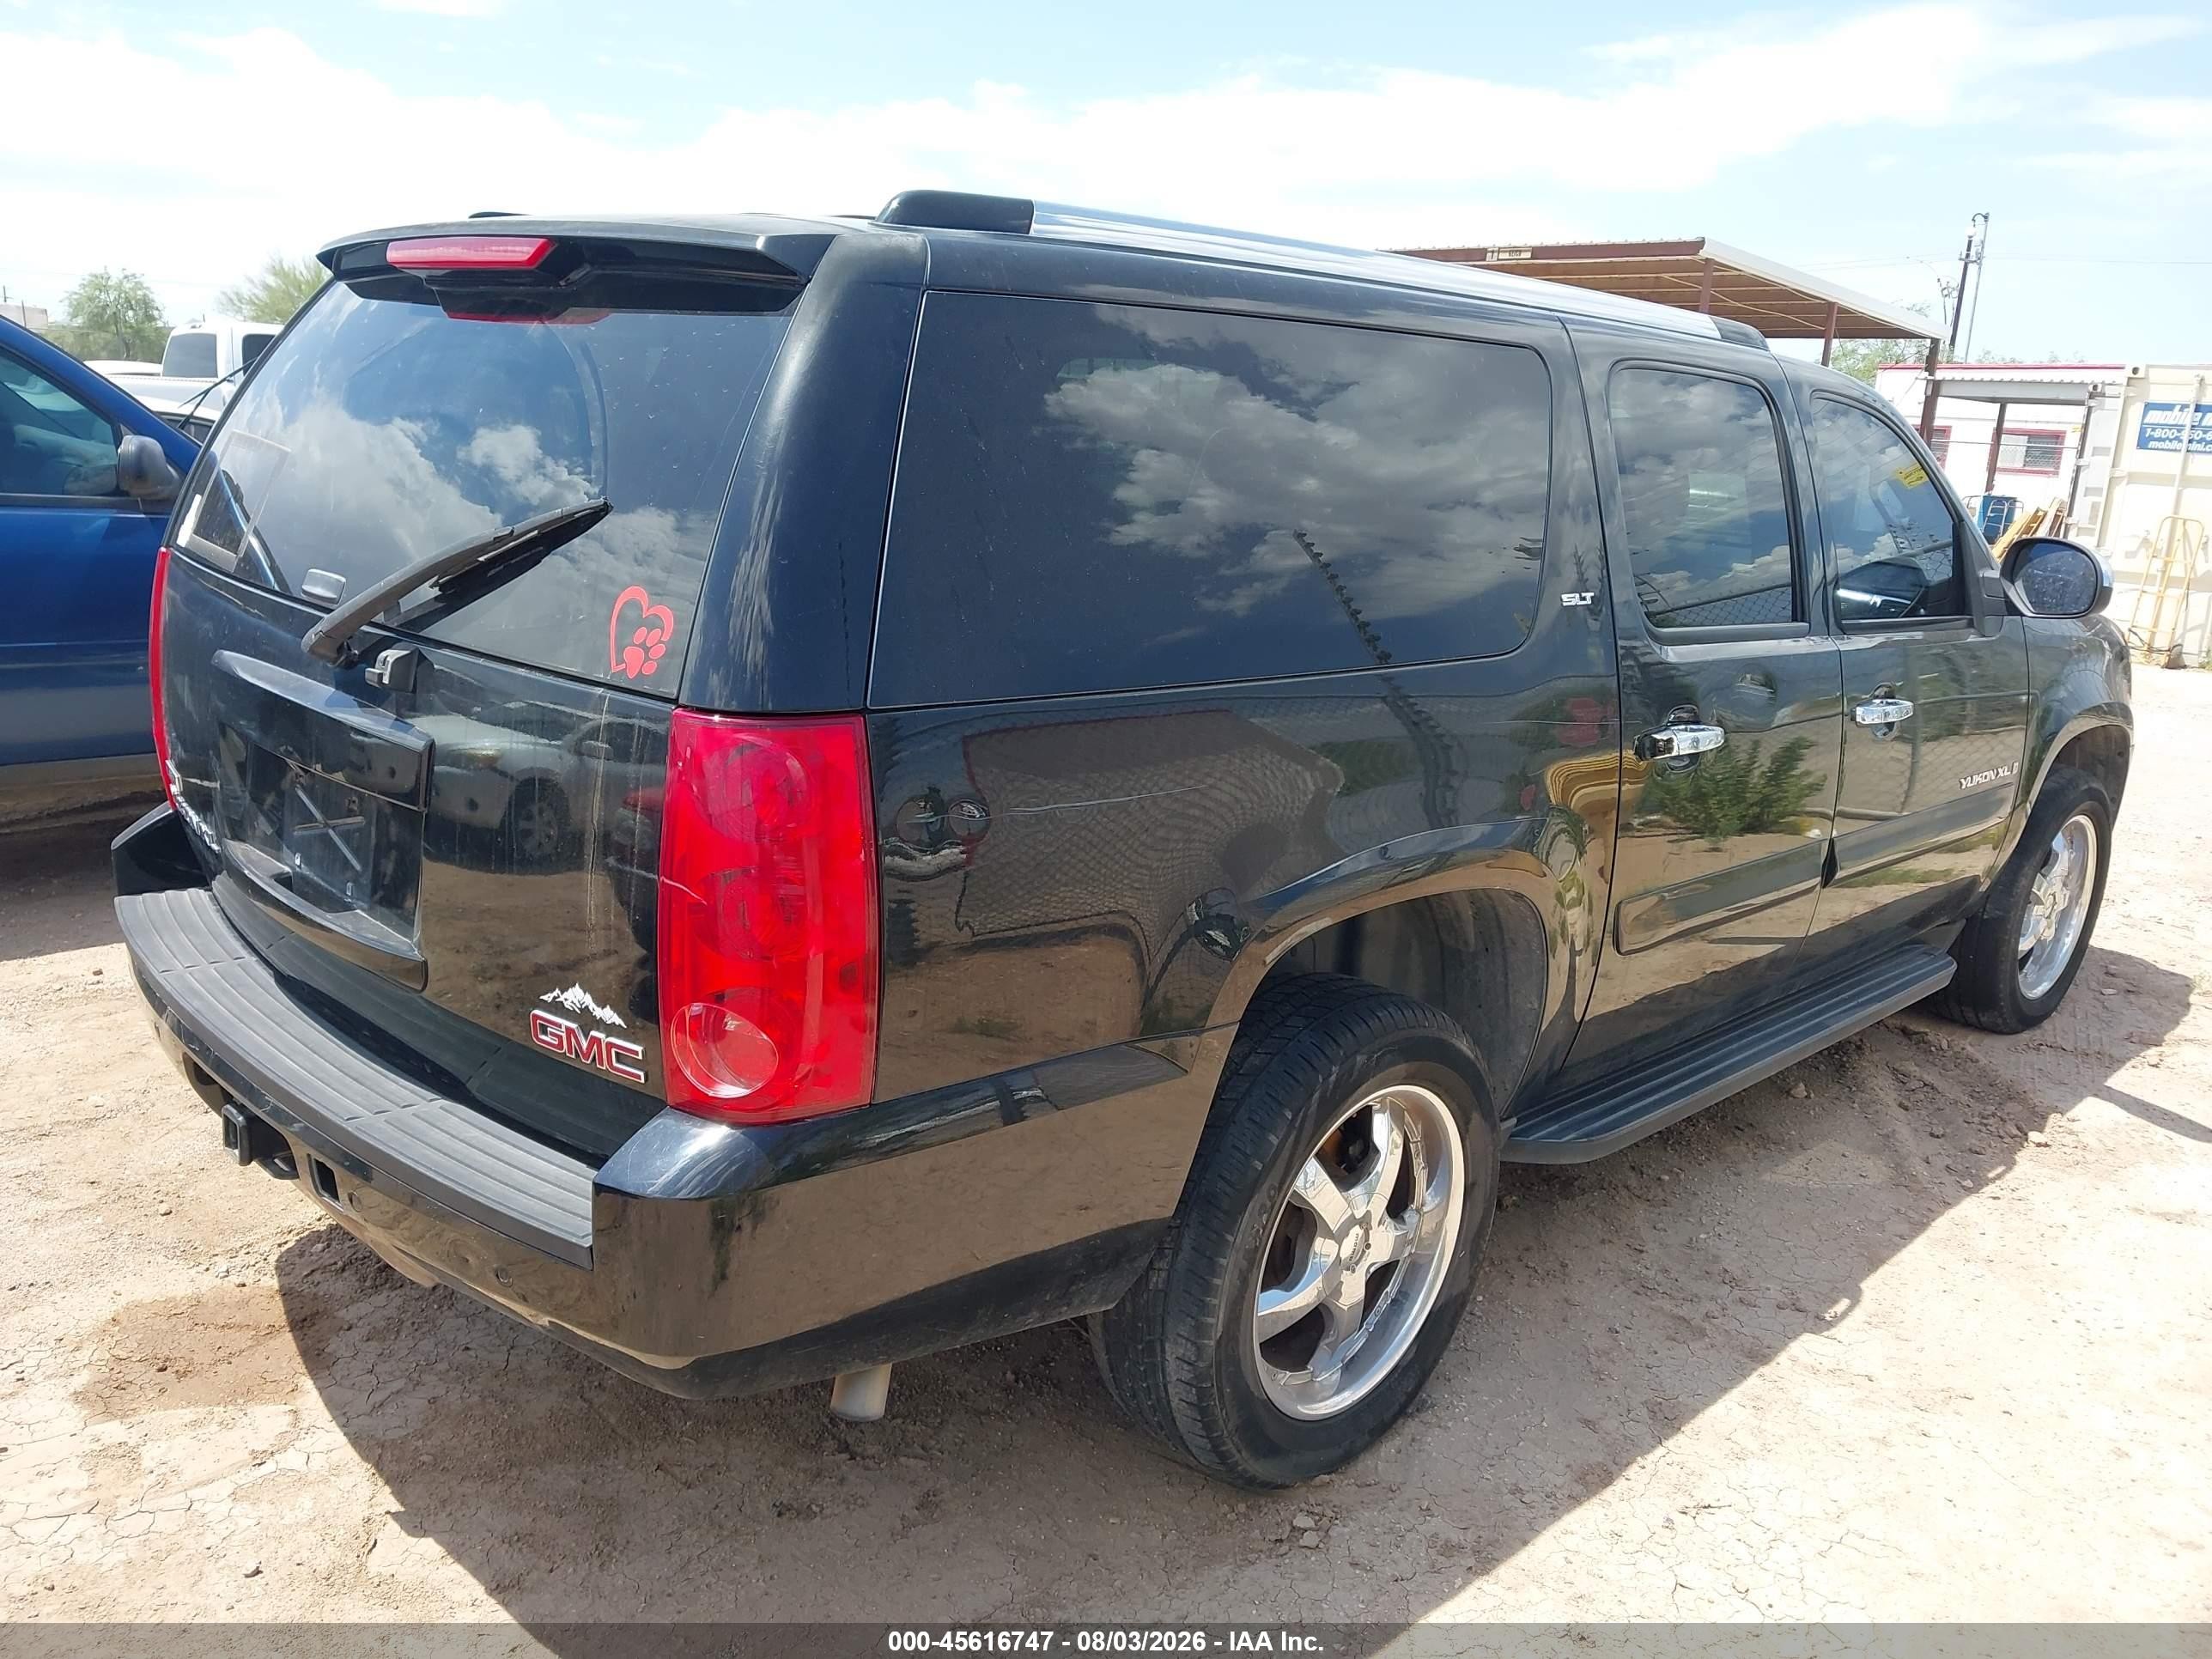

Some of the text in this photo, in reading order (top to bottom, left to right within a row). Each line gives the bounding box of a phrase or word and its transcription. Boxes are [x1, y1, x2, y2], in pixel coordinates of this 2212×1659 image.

[1561, 592, 1595, 606] SLT
[1959, 765, 2011, 789] YUKON XL
[530, 1009, 647, 1084] GMC
